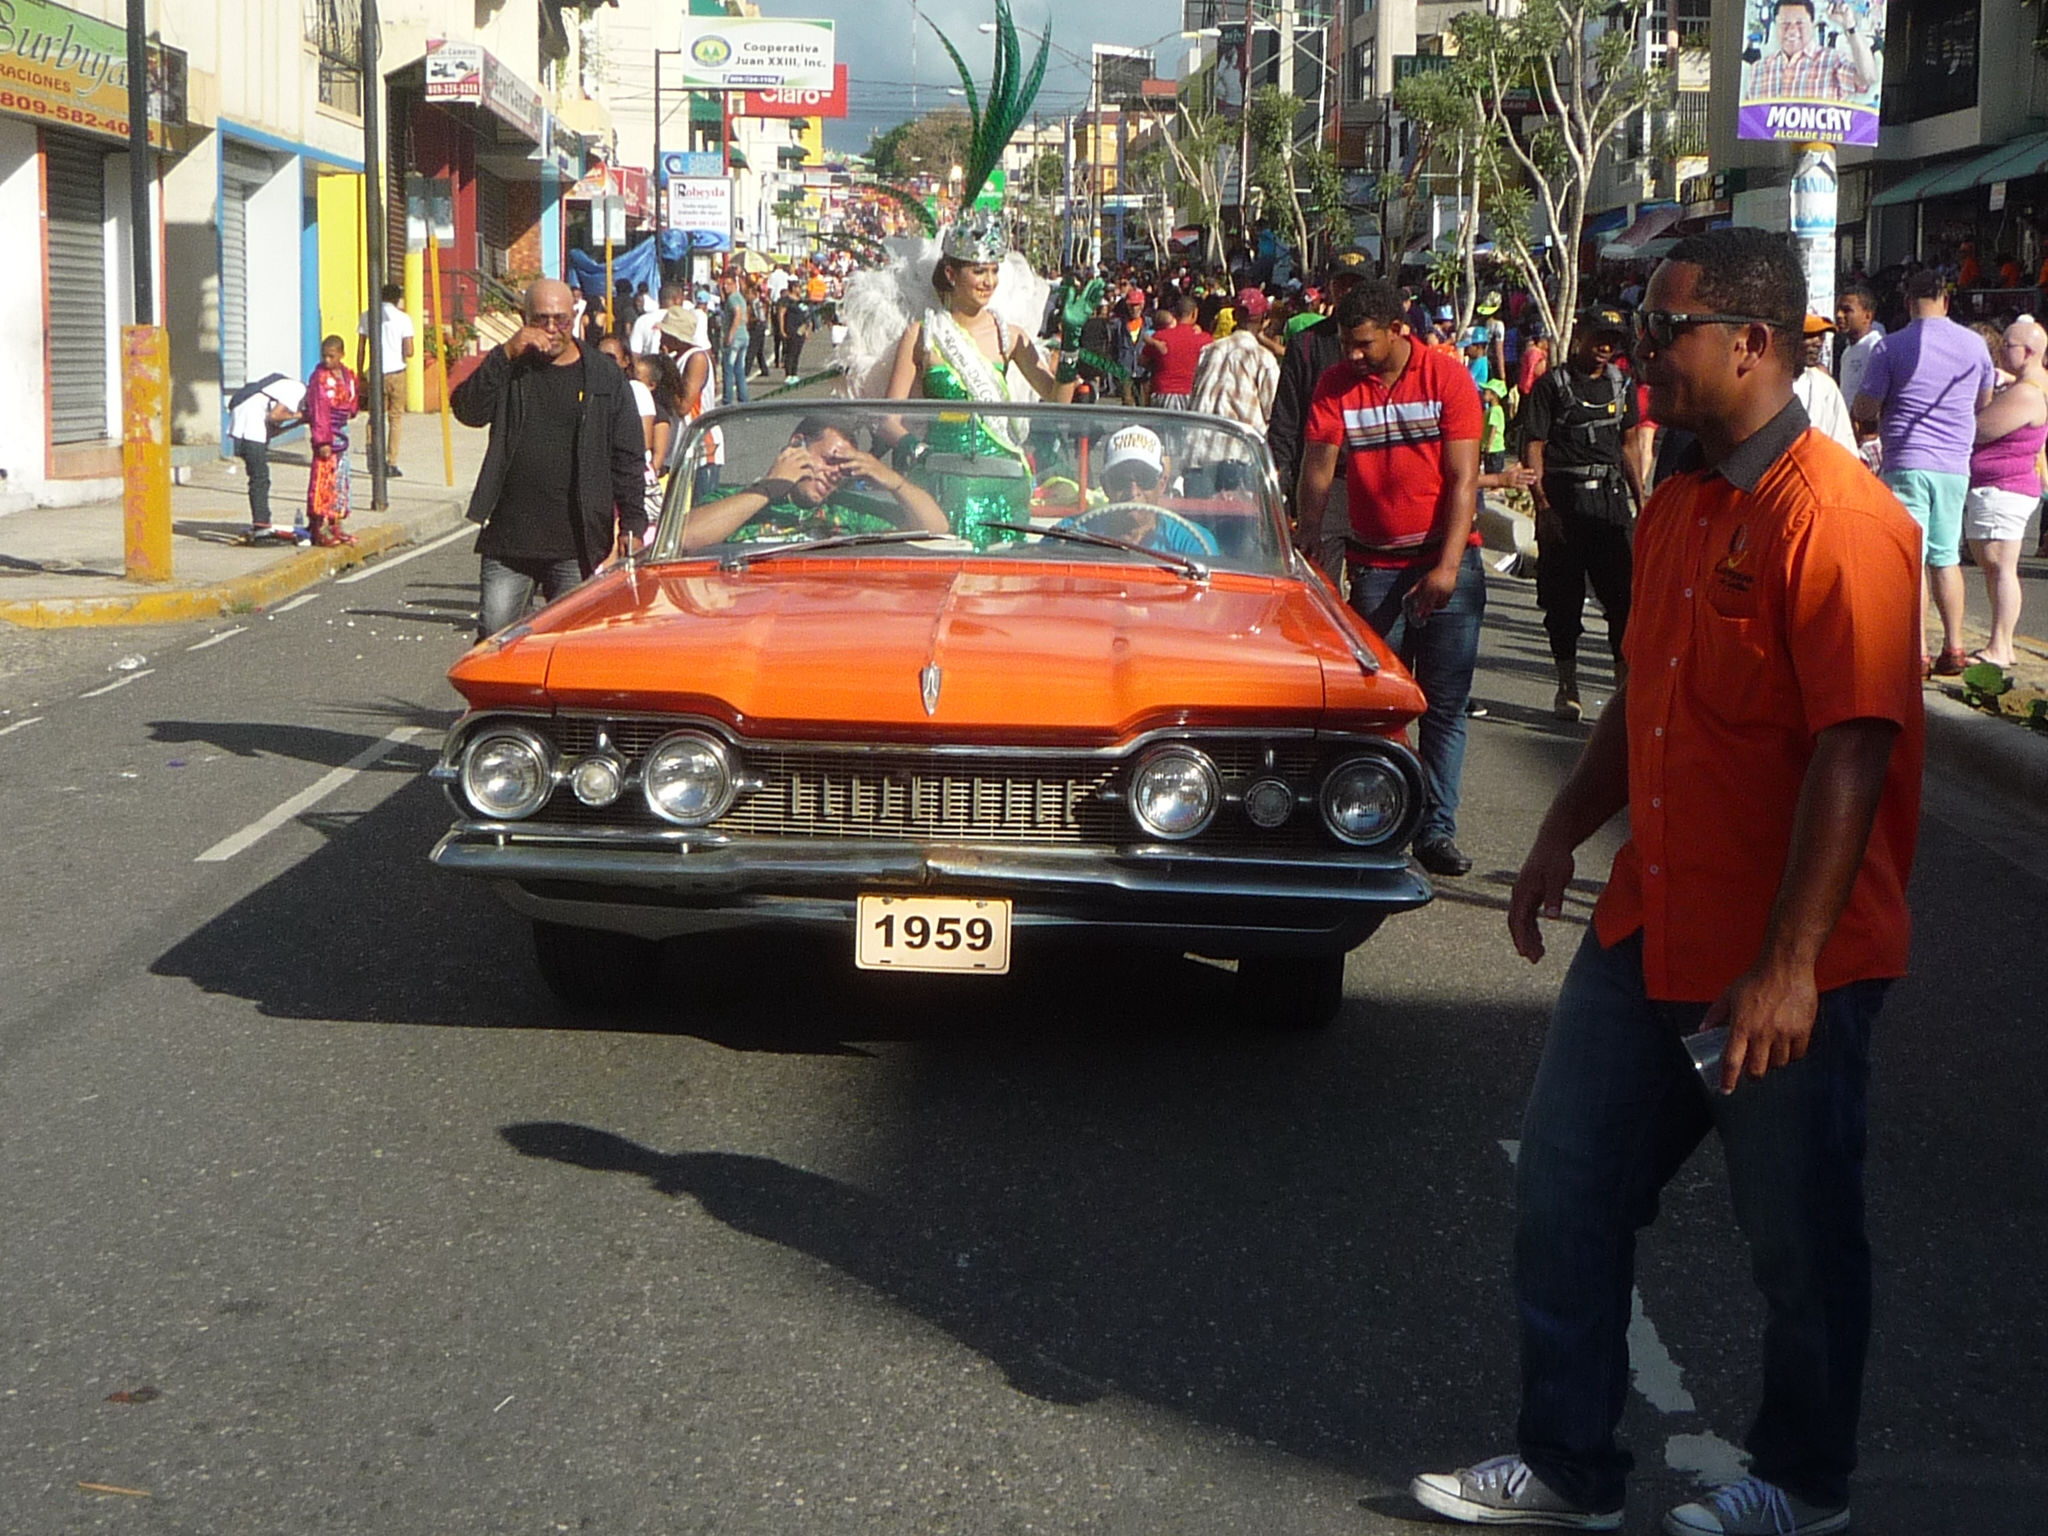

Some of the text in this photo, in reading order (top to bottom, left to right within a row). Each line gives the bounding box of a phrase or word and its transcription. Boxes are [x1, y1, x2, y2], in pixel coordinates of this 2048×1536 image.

[743, 42, 819, 54] Cooperativa
[735, 56, 764, 66] Juan
[804, 58, 826, 68] Inc.
[759, 87, 820, 104] Claro
[0, 92, 154, 142] 809-582-40
[1774, 130, 1818, 140] ALCALDE
[874, 914, 993, 951] 1959
